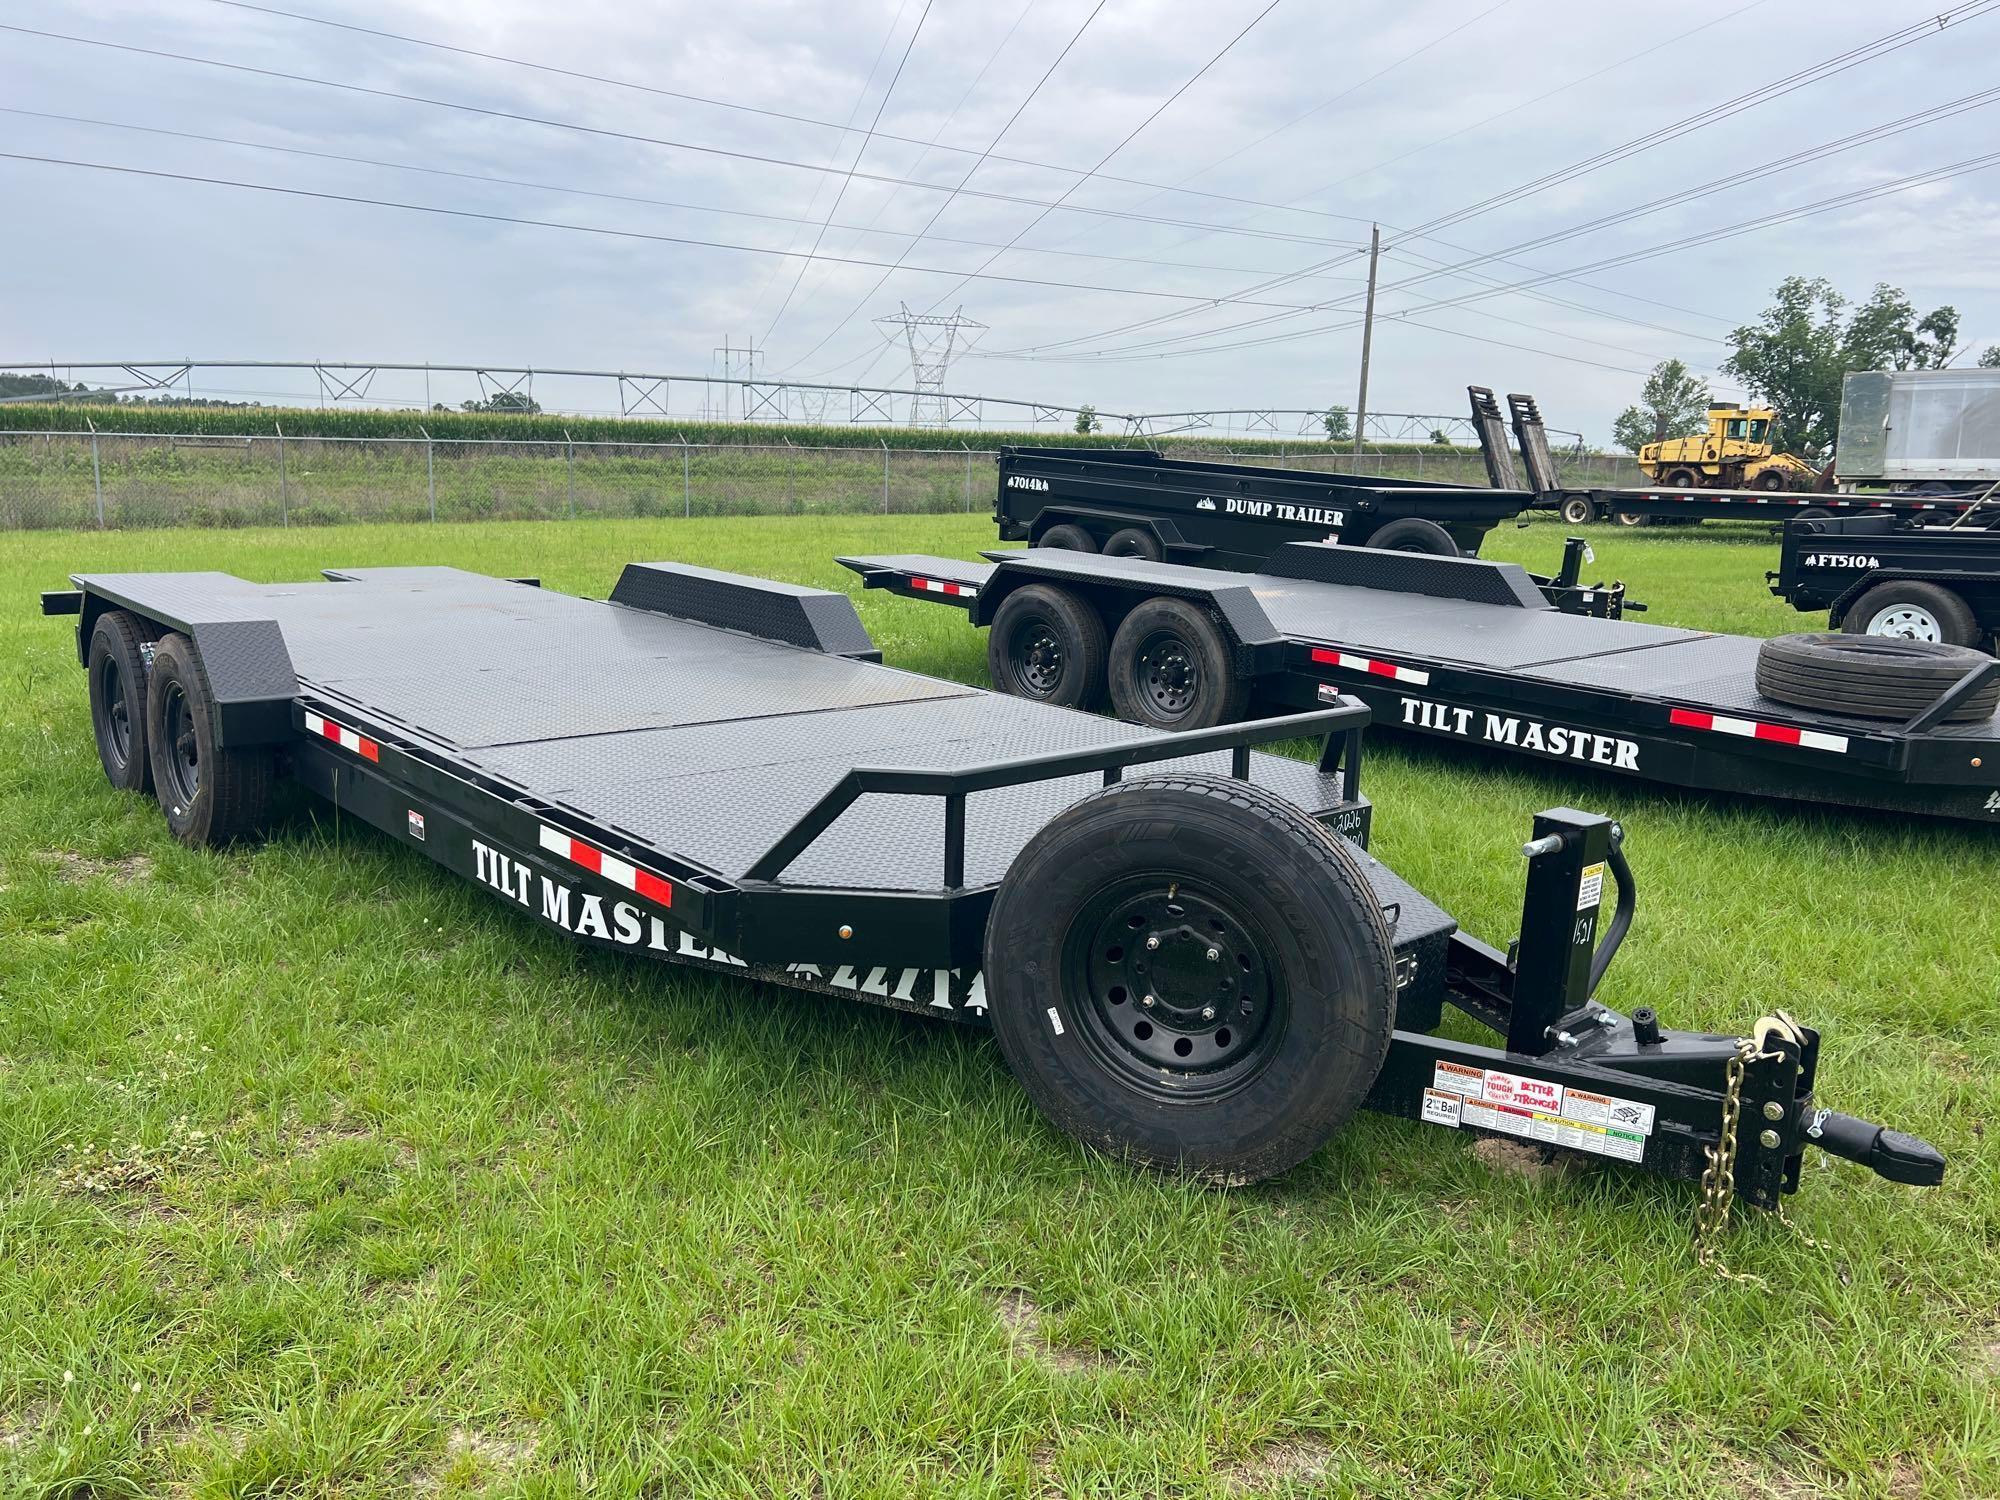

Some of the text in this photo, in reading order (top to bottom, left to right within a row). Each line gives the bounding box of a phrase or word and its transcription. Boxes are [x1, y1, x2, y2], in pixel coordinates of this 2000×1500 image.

[1225, 498, 1344, 527] DUMP TRAILER
[1818, 554, 1866, 569] FT510
[1401, 697, 1640, 771] TILT MASTER
[472, 839, 749, 968] TILT MAST
[1573, 917, 1593, 945] 1521
[1446, 1064, 1483, 1079] WARNING
[1487, 1082, 1513, 1094] TOUGH
[1521, 1081, 1554, 1097] BETTER
[1513, 1093, 1559, 1111] STRONGER
[1578, 1093, 1606, 1104] WARNING
[1427, 1110, 1456, 1121] REQUIRED
[1441, 1101, 1457, 1115] Ball
[1550, 1117, 1575, 1127] CAUTION
